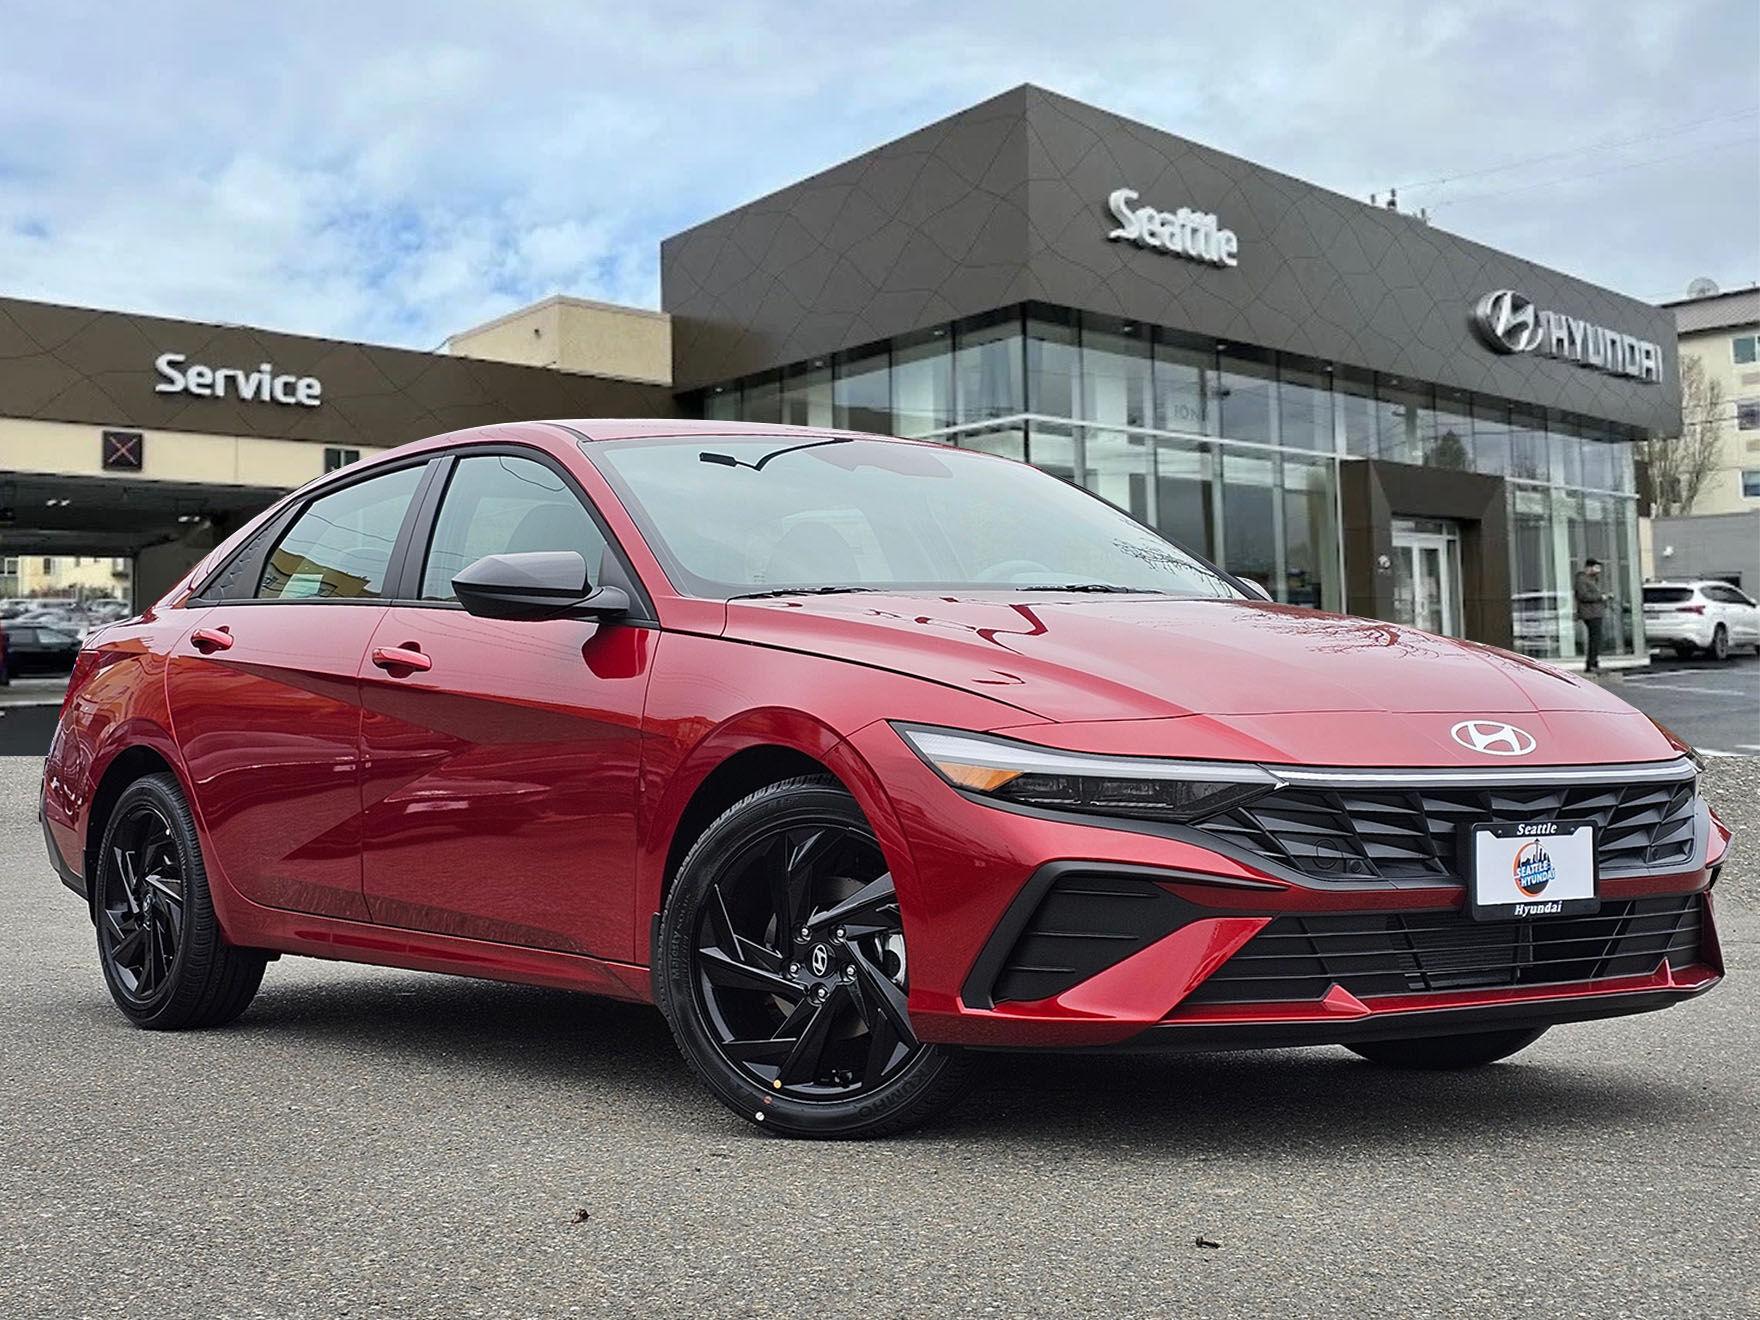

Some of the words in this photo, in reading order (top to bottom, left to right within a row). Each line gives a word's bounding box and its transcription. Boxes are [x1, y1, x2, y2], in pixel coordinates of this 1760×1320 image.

[1109, 188, 1238, 267] Seattle
[1542, 310, 1663, 383] HYUNDAI
[155, 353, 321, 406] Service
[1516, 823, 1558, 836] Seattle
[1516, 861, 1548, 877] SEATTLE
[1514, 901, 1563, 917] Hyundai
